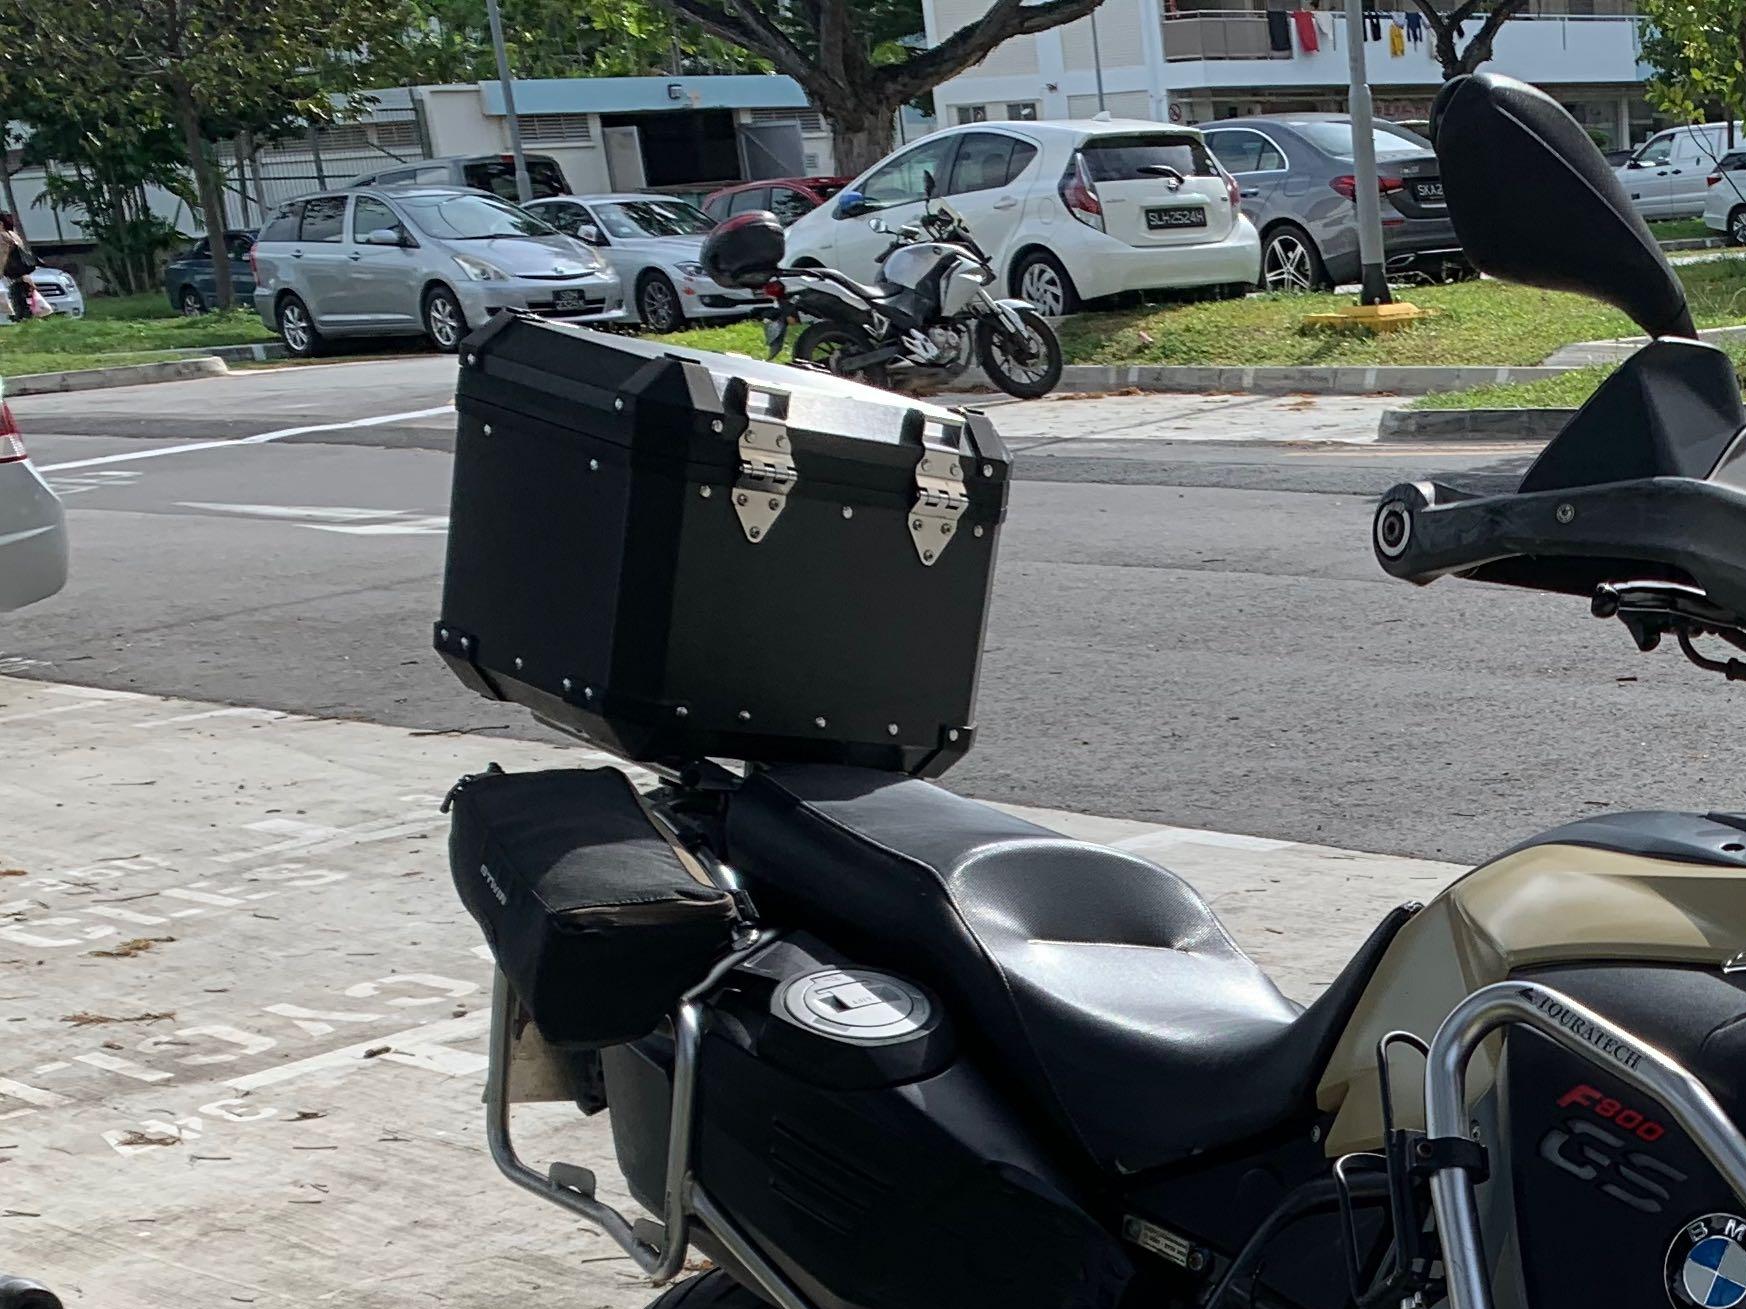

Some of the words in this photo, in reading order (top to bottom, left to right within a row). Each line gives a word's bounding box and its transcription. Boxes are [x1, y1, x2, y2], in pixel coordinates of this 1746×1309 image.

[1539, 997, 1642, 1070] TOURATECH
[1556, 1084, 1665, 1142] F800
[1539, 1119, 1688, 1213] GS
